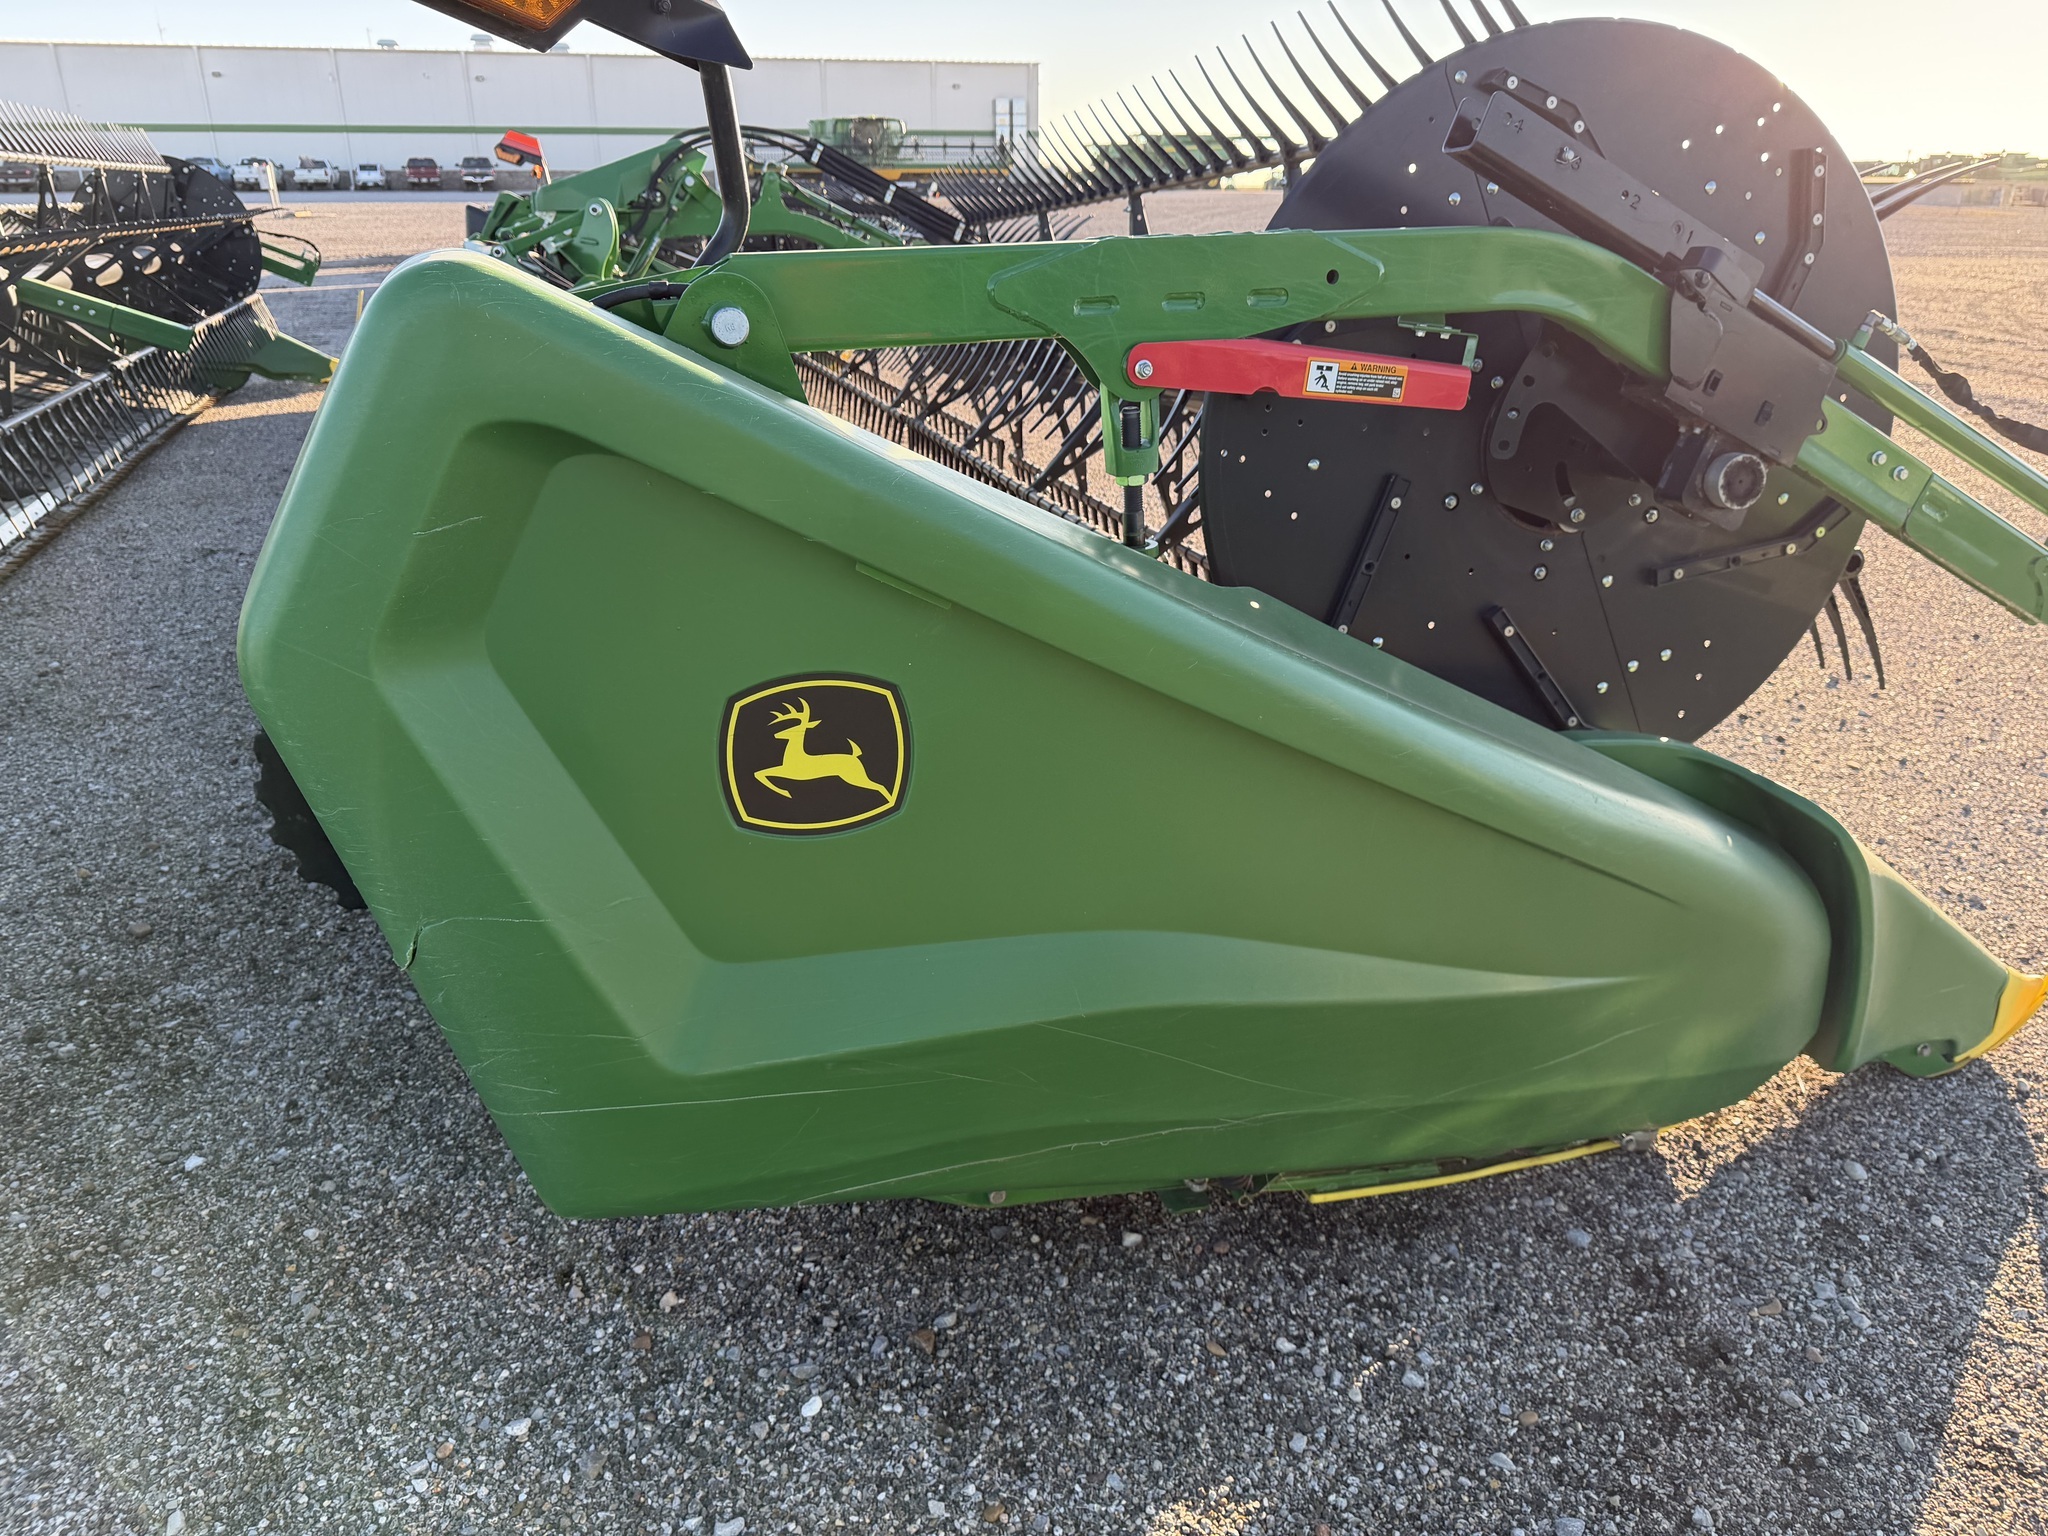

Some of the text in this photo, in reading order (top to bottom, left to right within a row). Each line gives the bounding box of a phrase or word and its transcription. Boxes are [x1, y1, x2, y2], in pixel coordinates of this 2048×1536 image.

[1514, 119, 1524, 134] 4
[1630, 194, 1641, 210] 2
[1686, 230, 1694, 244] 1
[1361, 364, 1396, 373] WARNING
